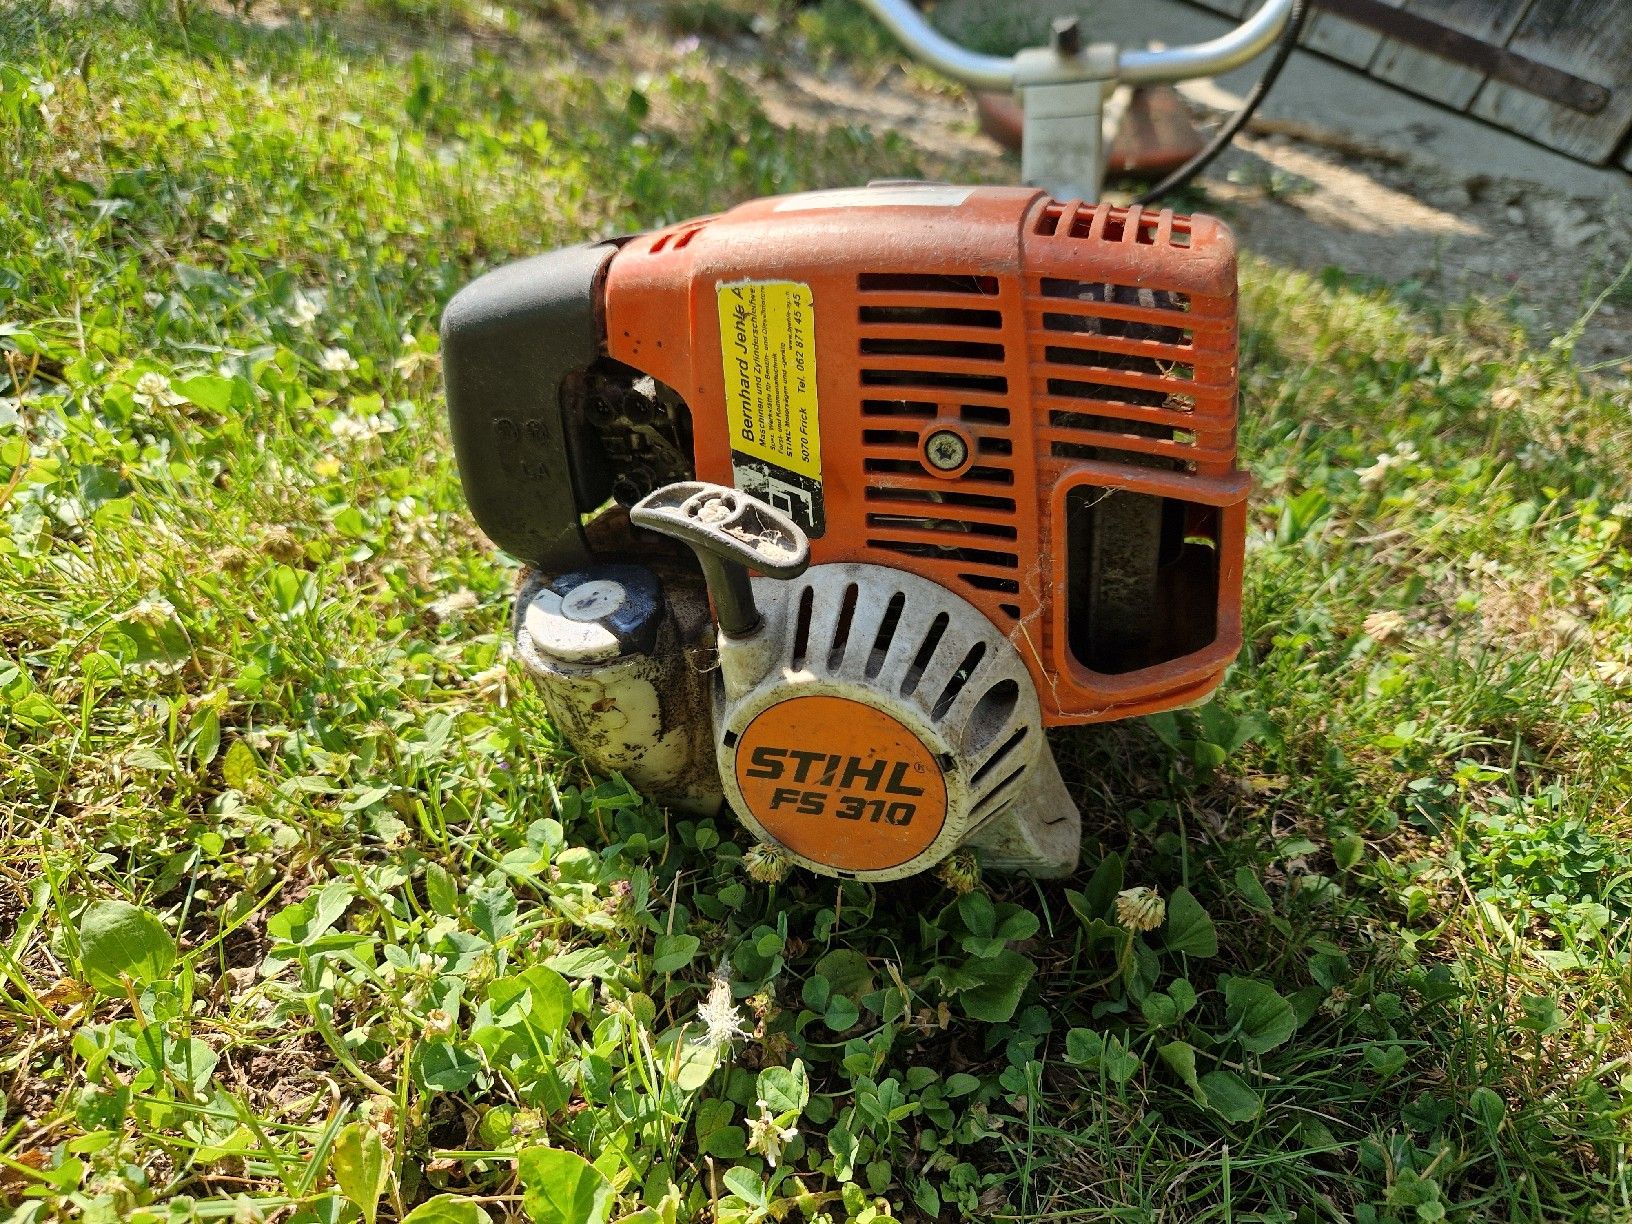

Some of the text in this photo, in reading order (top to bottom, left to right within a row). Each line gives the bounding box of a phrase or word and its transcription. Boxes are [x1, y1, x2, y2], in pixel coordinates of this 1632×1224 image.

[793, 294, 801, 307] 45
[794, 311, 801, 325] 45
[733, 305, 747, 354] Jehle
[795, 328, 803, 348] 871
[796, 351, 804, 371] 062
[797, 377, 805, 392] Tel.
[736, 358, 754, 441] Bernhard
[758, 398, 766, 447] Maschinen
[801, 438, 809, 463] 5070
[769, 788, 916, 826] FS 310
